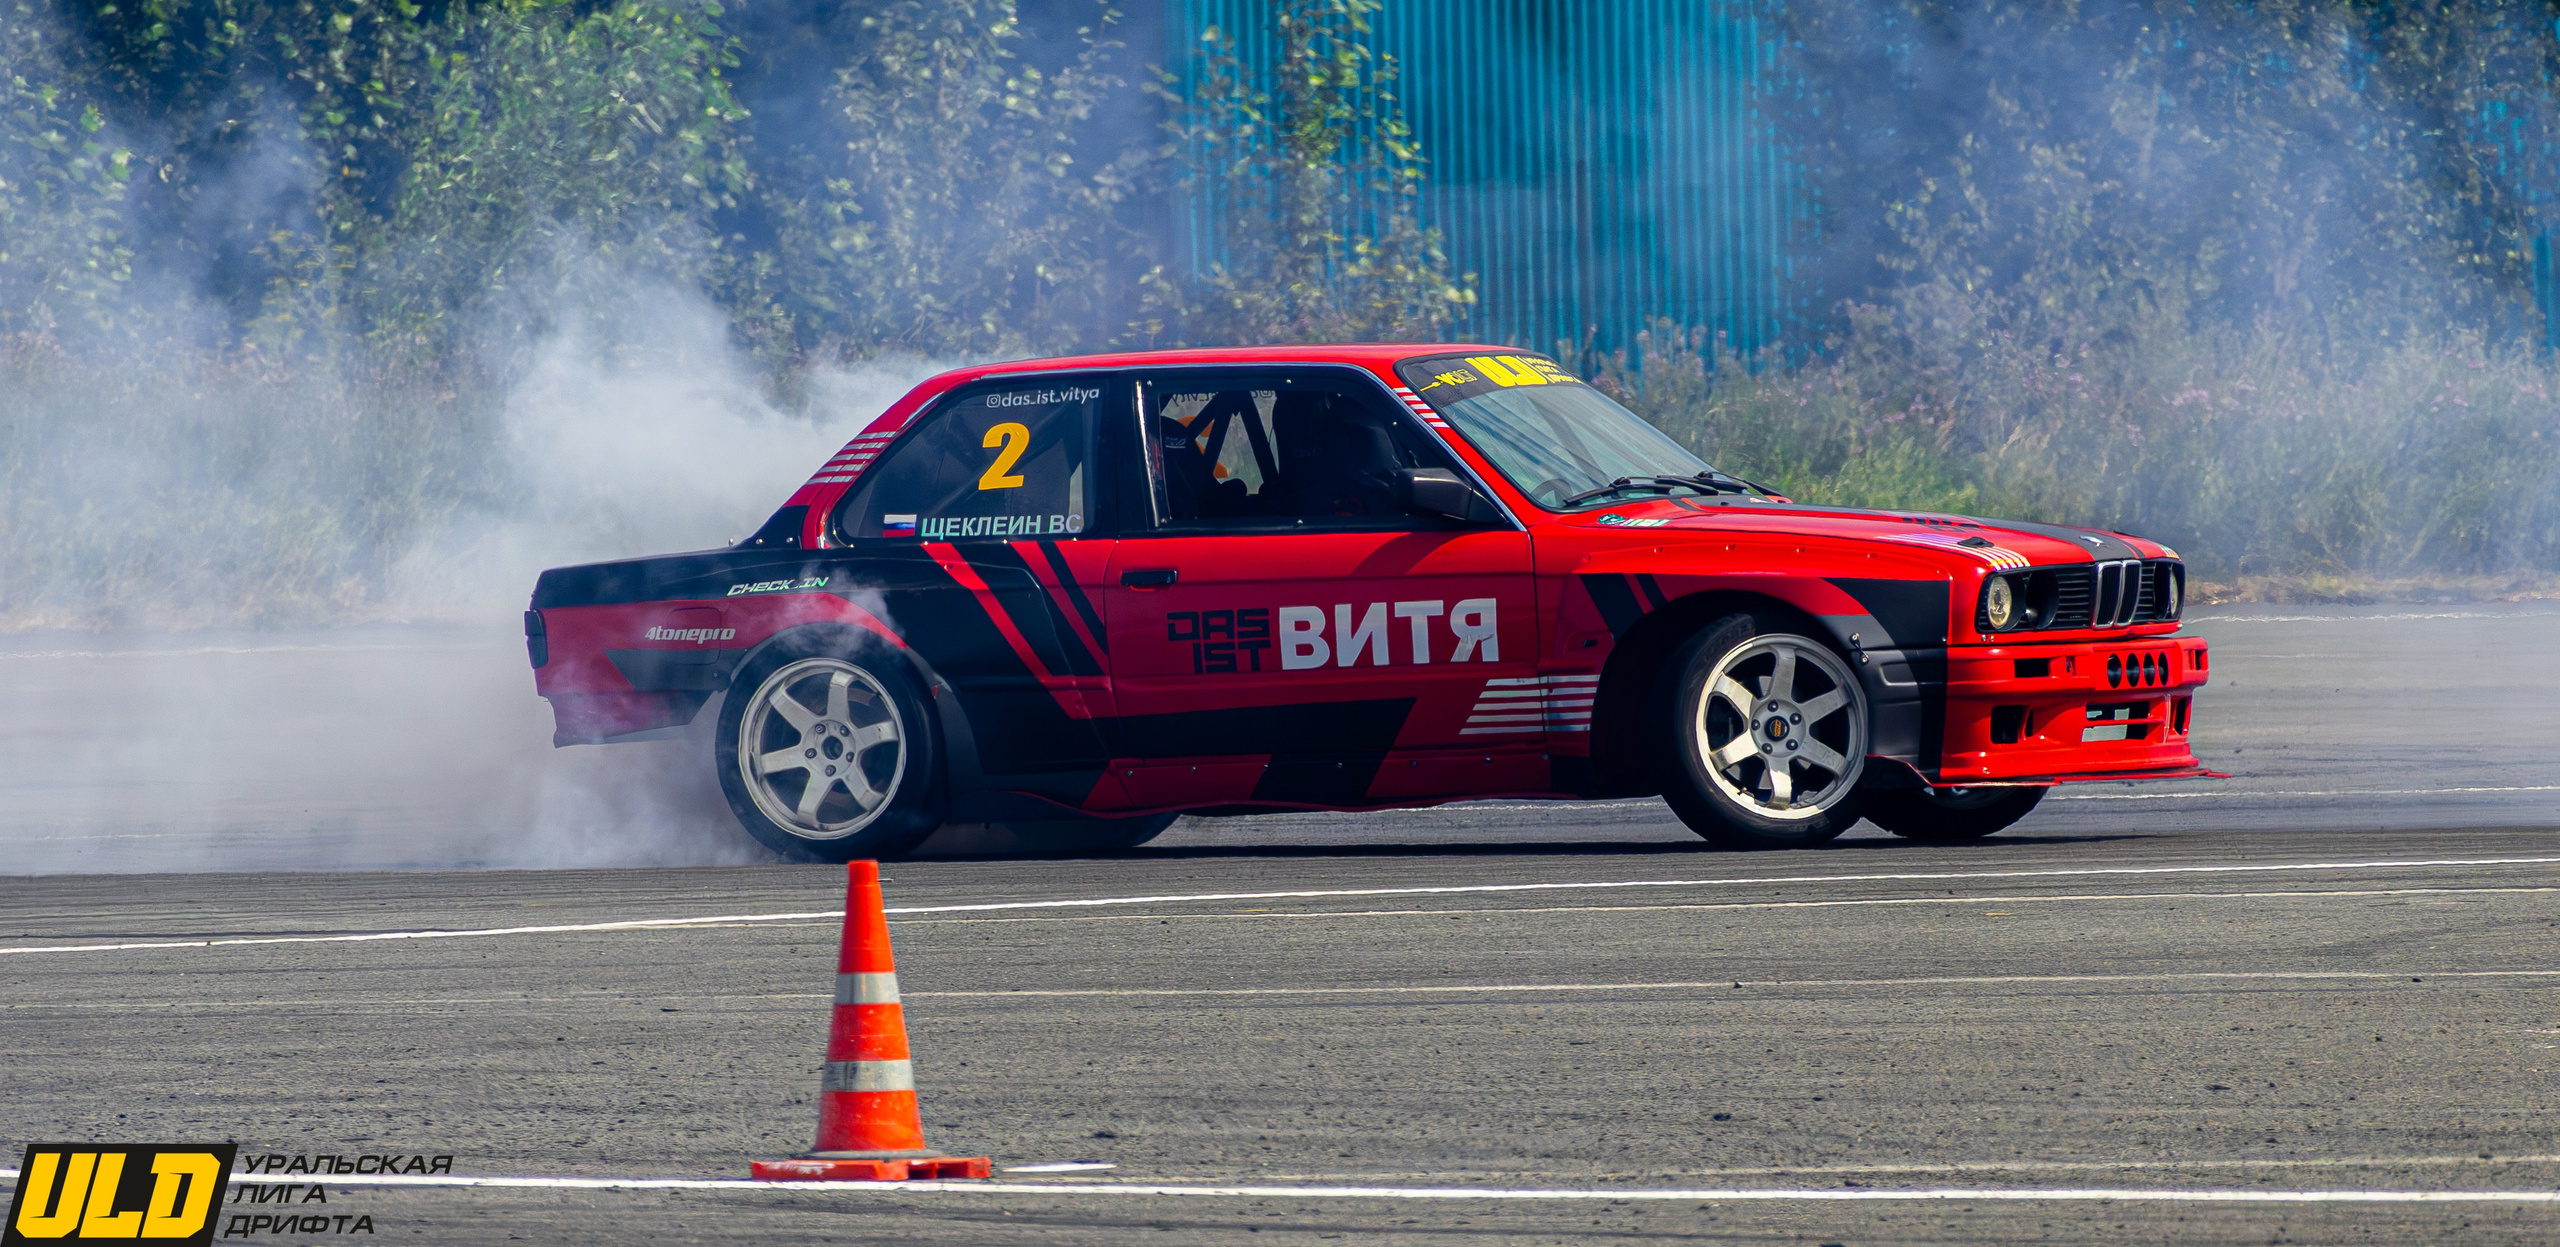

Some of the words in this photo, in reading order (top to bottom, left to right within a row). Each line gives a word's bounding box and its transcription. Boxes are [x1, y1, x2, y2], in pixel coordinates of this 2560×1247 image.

[1001, 386, 1100, 408] das_ist_vitya
[978, 422, 1030, 491] 2
[920, 514, 1042, 541] ЩЕКЛЕИН
[1048, 514, 1082, 534] ВС
[644, 625, 736, 645] 4tonepro
[1166, 607, 1270, 642] DAS
[1279, 597, 1500, 671] ВИТЯ
[1192, 639, 1271, 674] IST
